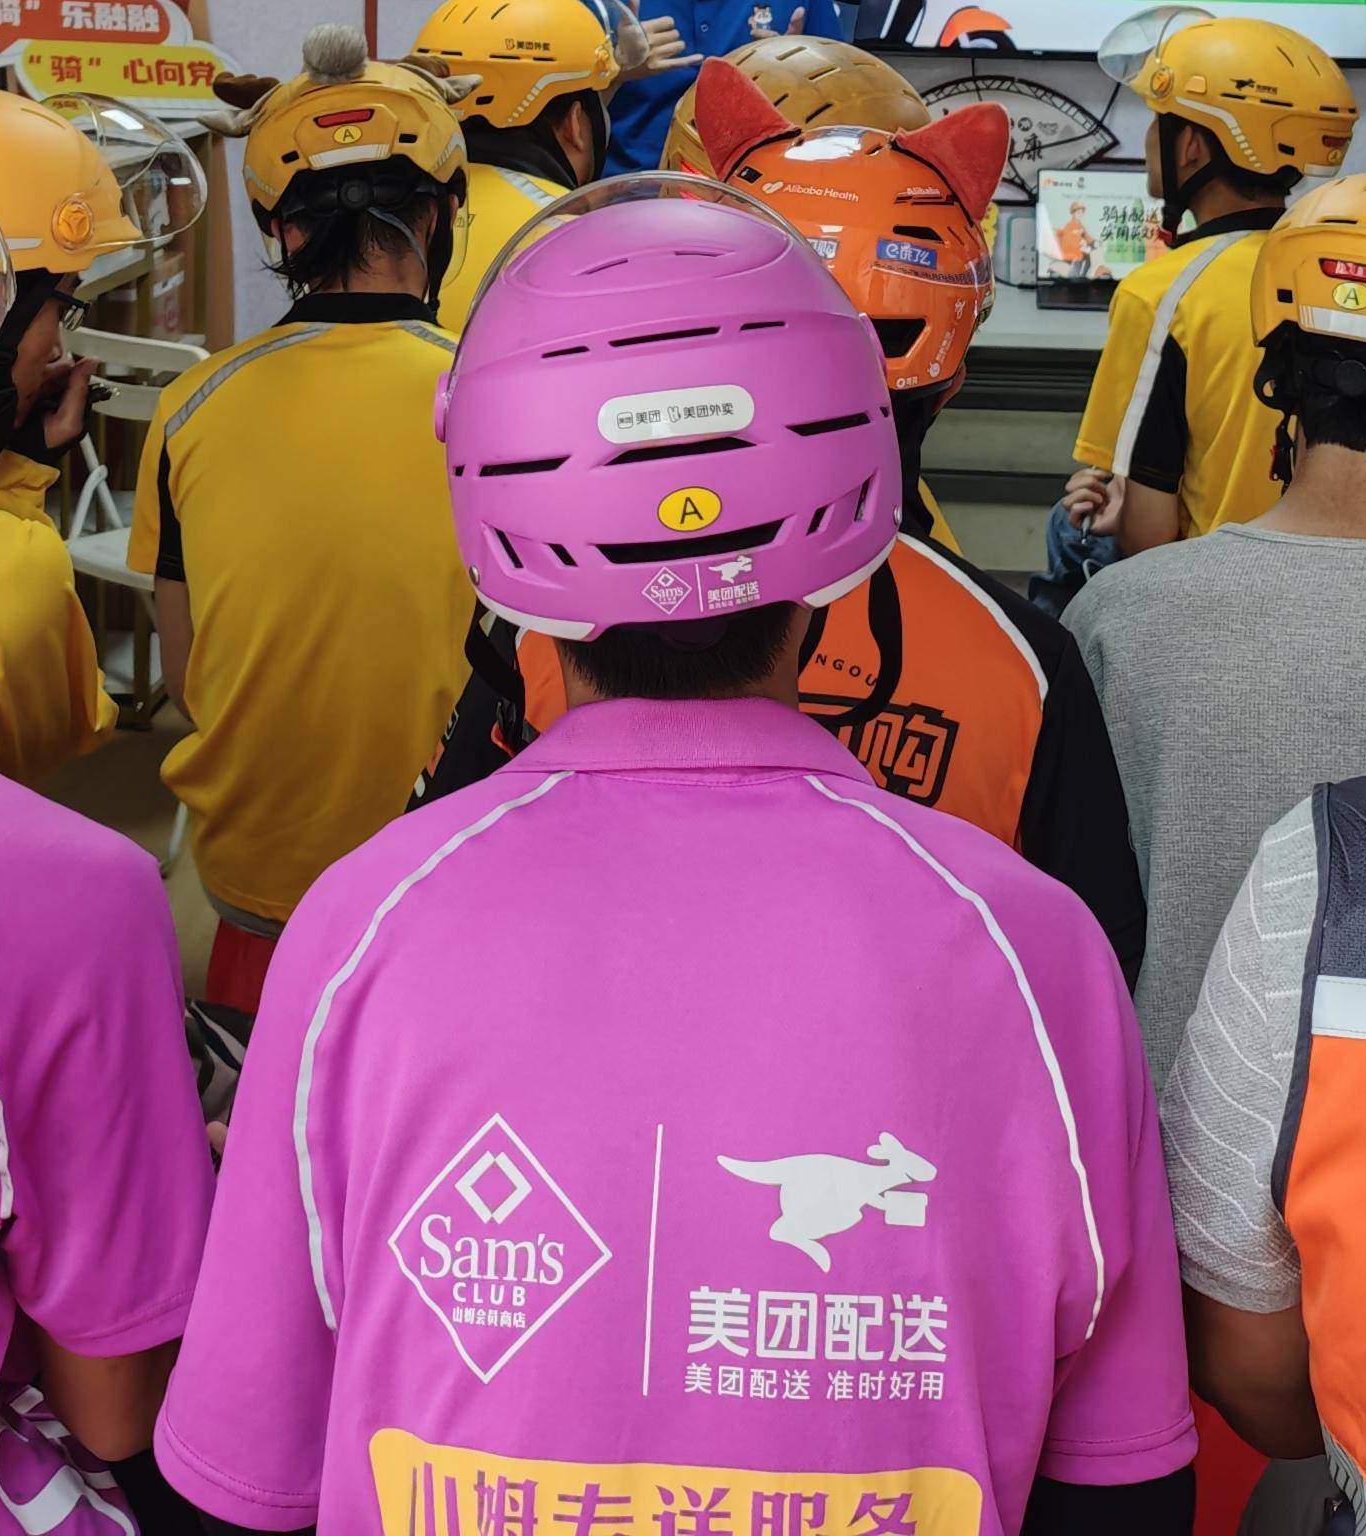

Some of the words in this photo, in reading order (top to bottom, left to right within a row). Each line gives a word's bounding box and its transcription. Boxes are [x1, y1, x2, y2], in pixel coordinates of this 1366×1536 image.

[29, 55, 216, 87] “骑”心向党
[342, 127, 354, 142] A
[783, 183, 823, 196] Alibaba
[824, 187, 859, 203] Health
[1100, 206, 1161, 224] 骑手配送
[1343, 287, 1360, 306] A
[636, 409, 662, 425] 美团
[683, 401, 734, 421] 美团外卖
[679, 496, 705, 525] A
[707, 582, 761, 604] 美团配送
[420, 1213, 564, 1286] Sam's
[452, 1281, 527, 1307] CLUB
[452, 1306, 526, 1330] 山姆会员商店
[686, 1285, 948, 1364] 美团配送
[684, 1363, 810, 1400] 美团配送
[826, 1370, 945, 1402] 准时好用
